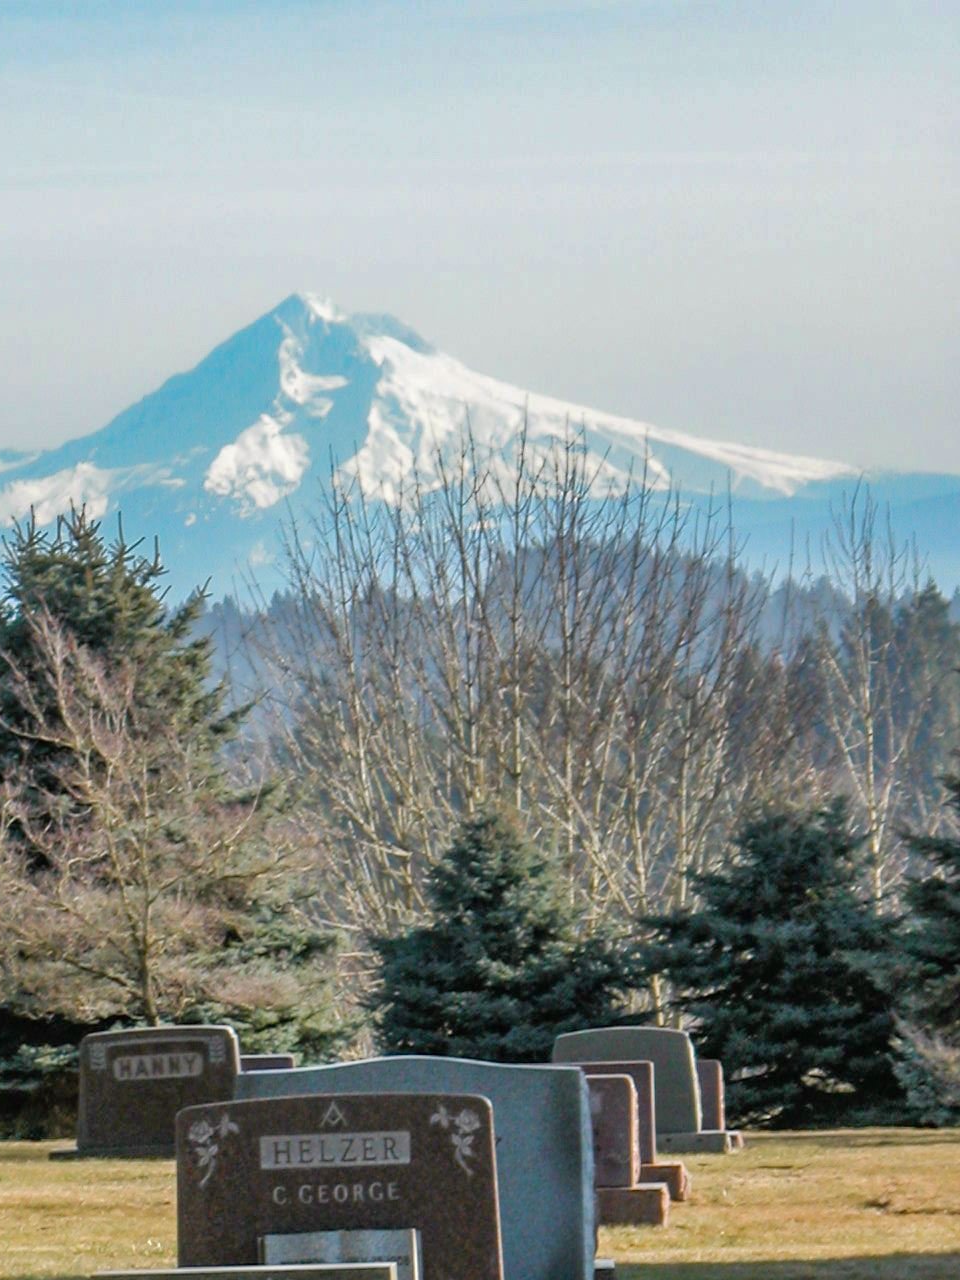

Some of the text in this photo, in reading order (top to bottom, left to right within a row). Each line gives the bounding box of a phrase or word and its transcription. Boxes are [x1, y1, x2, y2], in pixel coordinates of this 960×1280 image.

[118, 1055, 198, 1078] HANNY
[272, 1137, 400, 1164] HELZER
[299, 1182, 401, 1203] GEORGE
